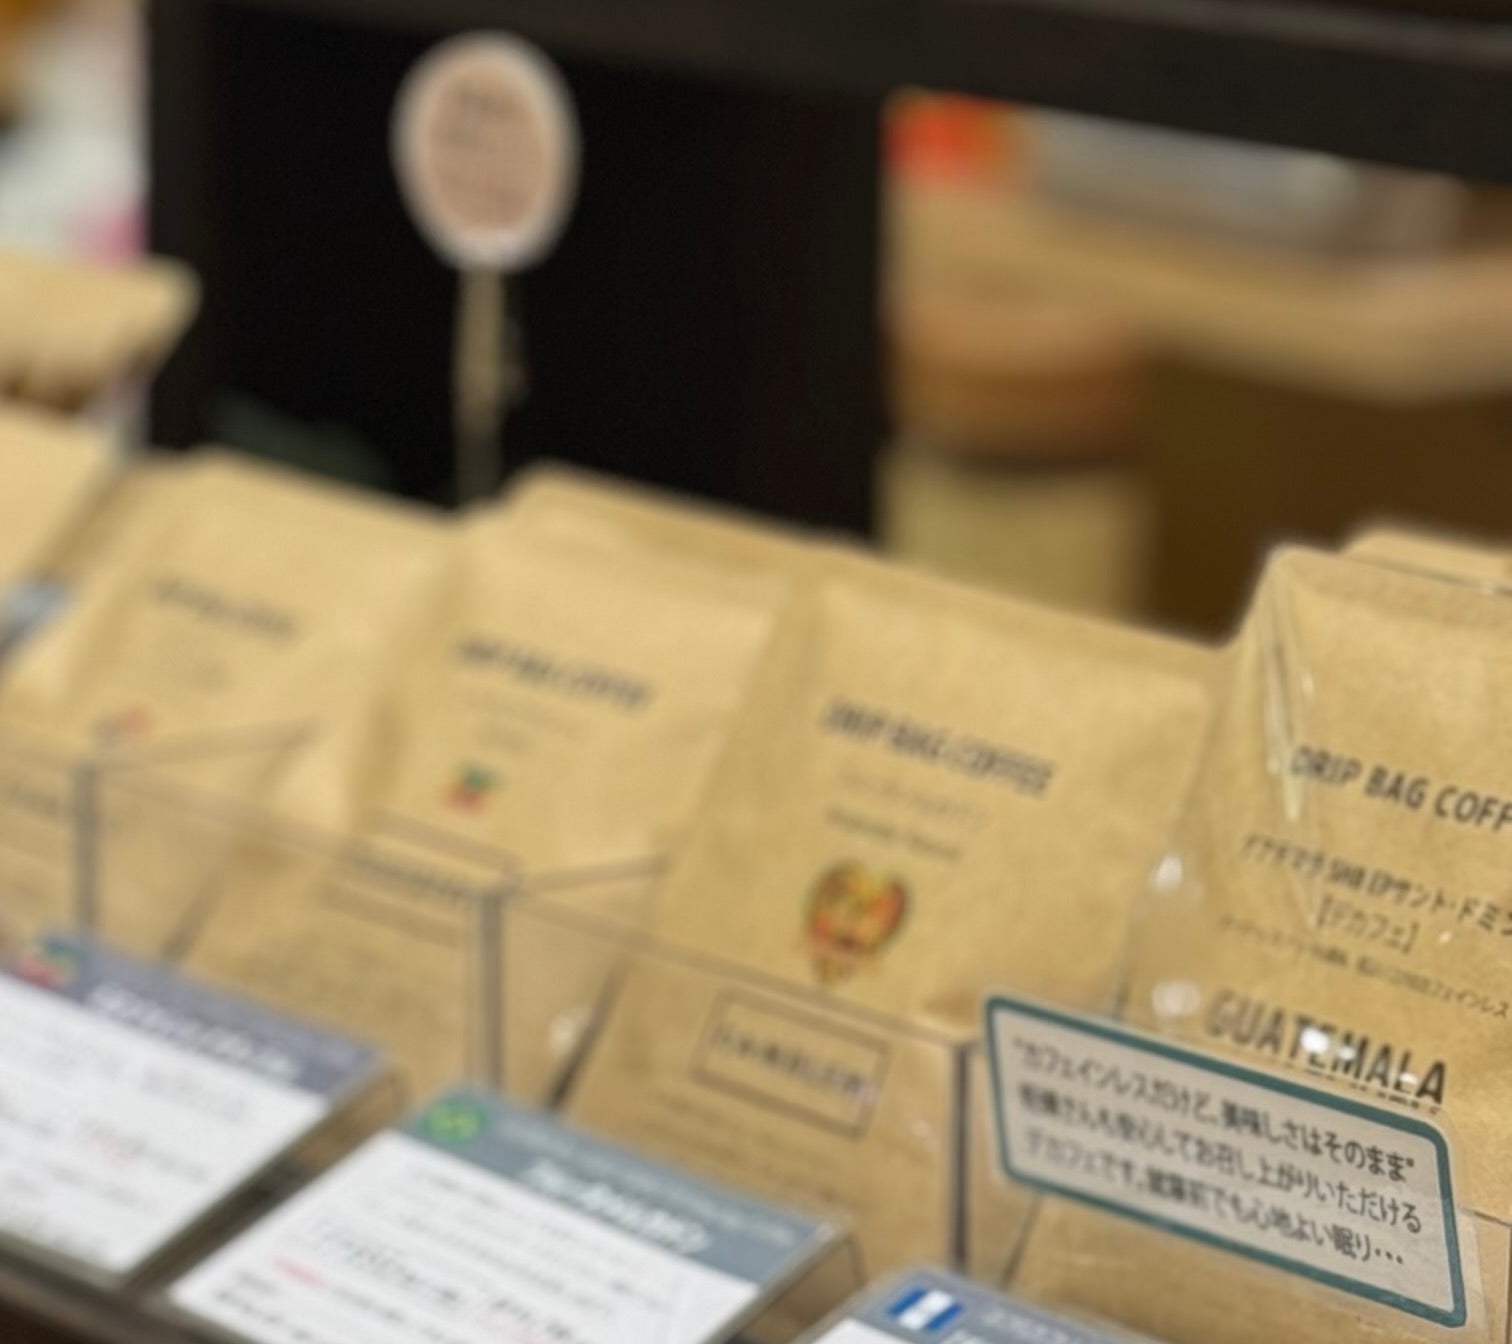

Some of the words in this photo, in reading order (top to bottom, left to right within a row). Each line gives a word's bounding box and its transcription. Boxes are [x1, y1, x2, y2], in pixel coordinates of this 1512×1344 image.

[1290, 746, 1361, 782] DRIP
[1365, 766, 1425, 808] BAG
[1205, 986, 1448, 1106] GUATEMALA
